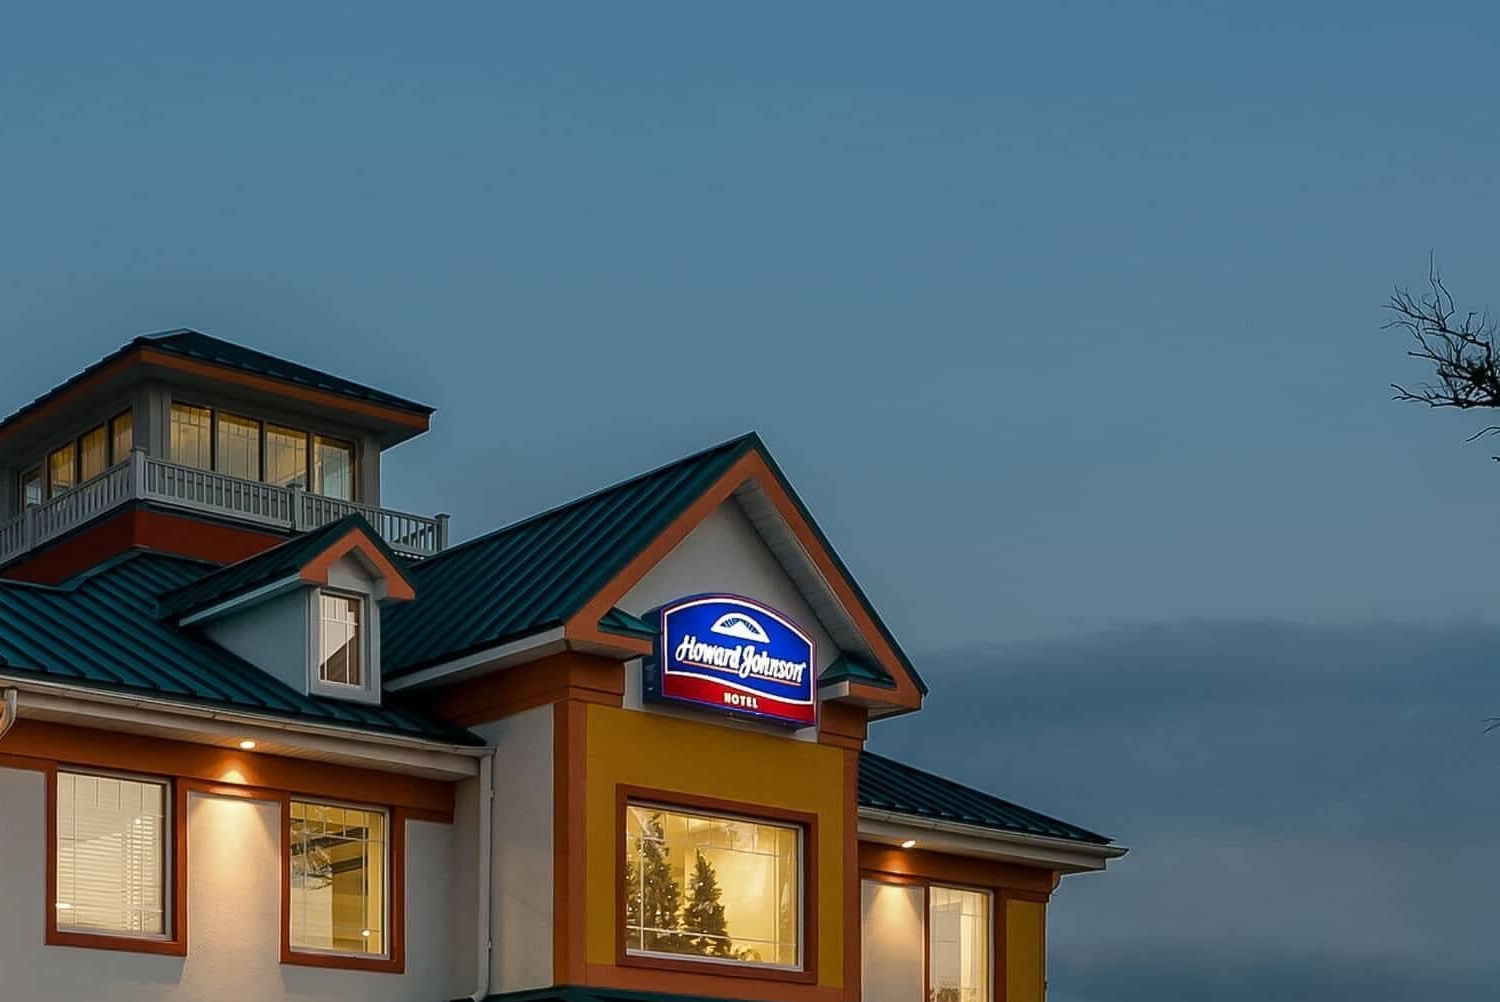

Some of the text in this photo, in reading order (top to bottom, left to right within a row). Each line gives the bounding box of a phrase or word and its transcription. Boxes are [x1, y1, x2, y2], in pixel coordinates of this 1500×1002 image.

[675, 634, 807, 682] Howard Johnson
[723, 692, 759, 709] HOTEL
